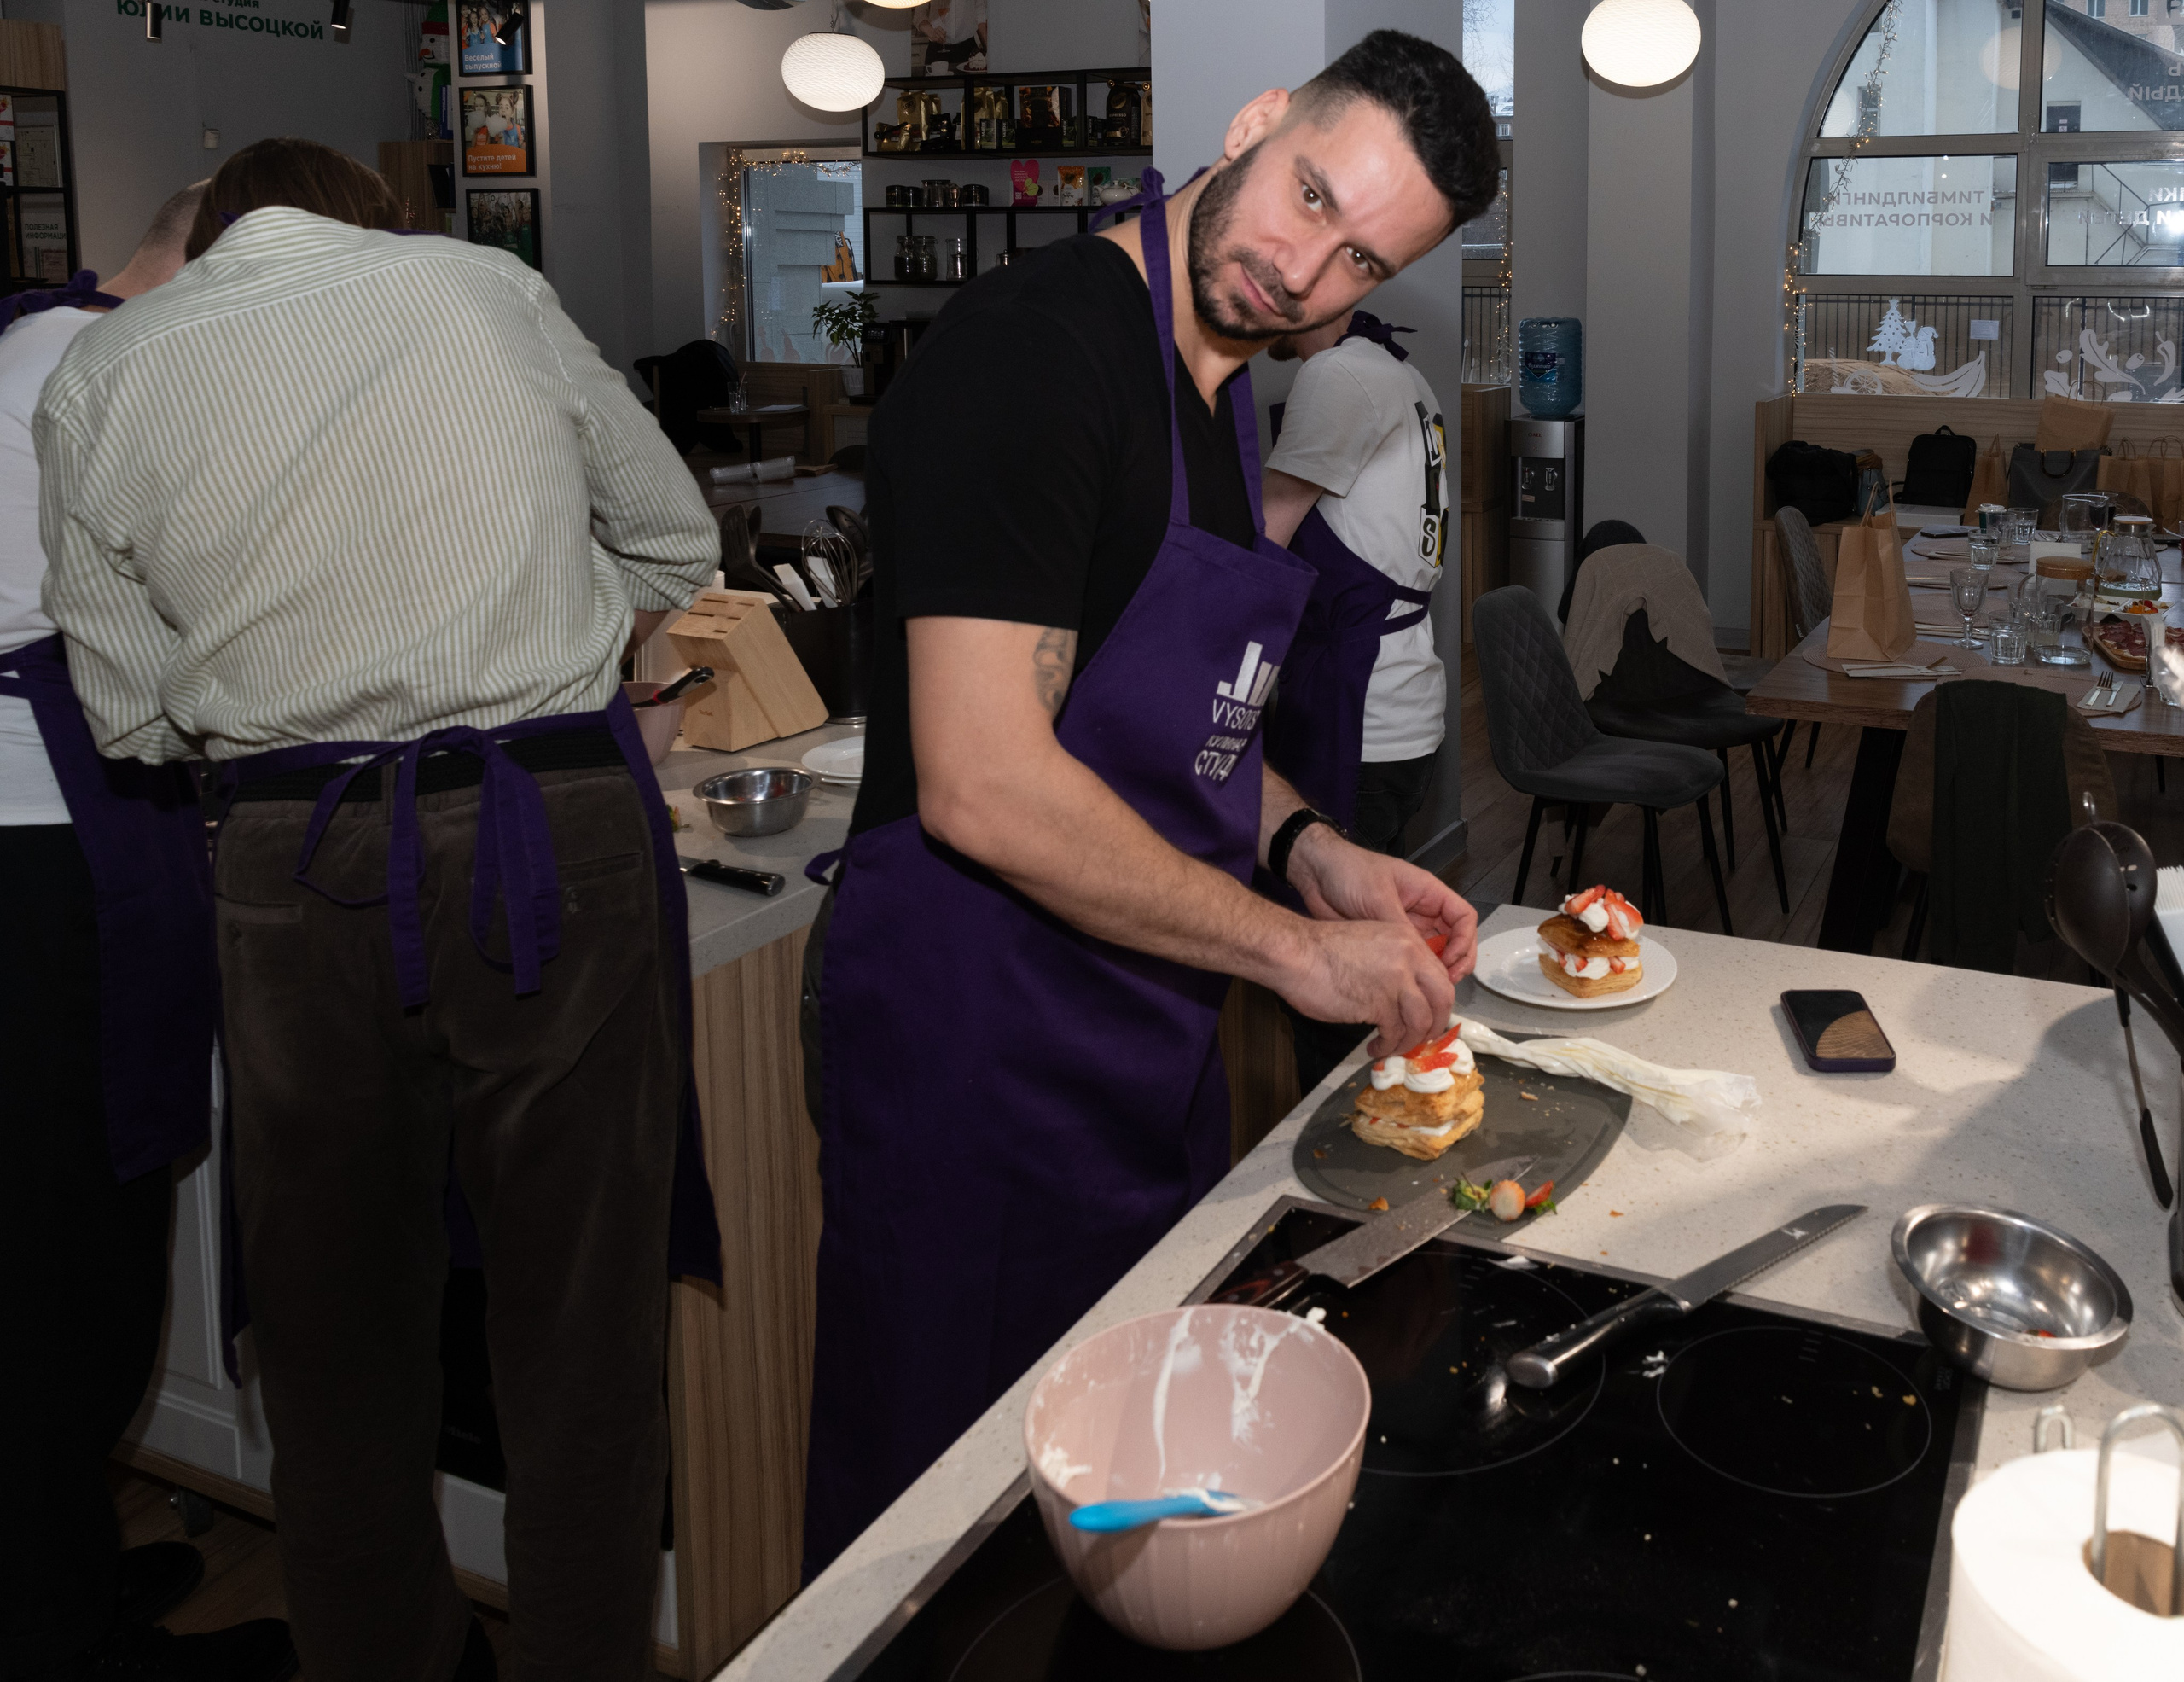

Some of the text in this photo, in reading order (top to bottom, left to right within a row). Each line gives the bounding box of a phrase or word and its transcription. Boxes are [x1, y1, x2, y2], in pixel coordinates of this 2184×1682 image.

[200, 9, 324, 40] ВЫСОЦКОЙ
[464, 53, 494, 61] Веселый
[465, 61, 502, 71] выпускной
[468, 153, 517, 163] Пустите детей
[478, 162, 502, 172] кухню!
